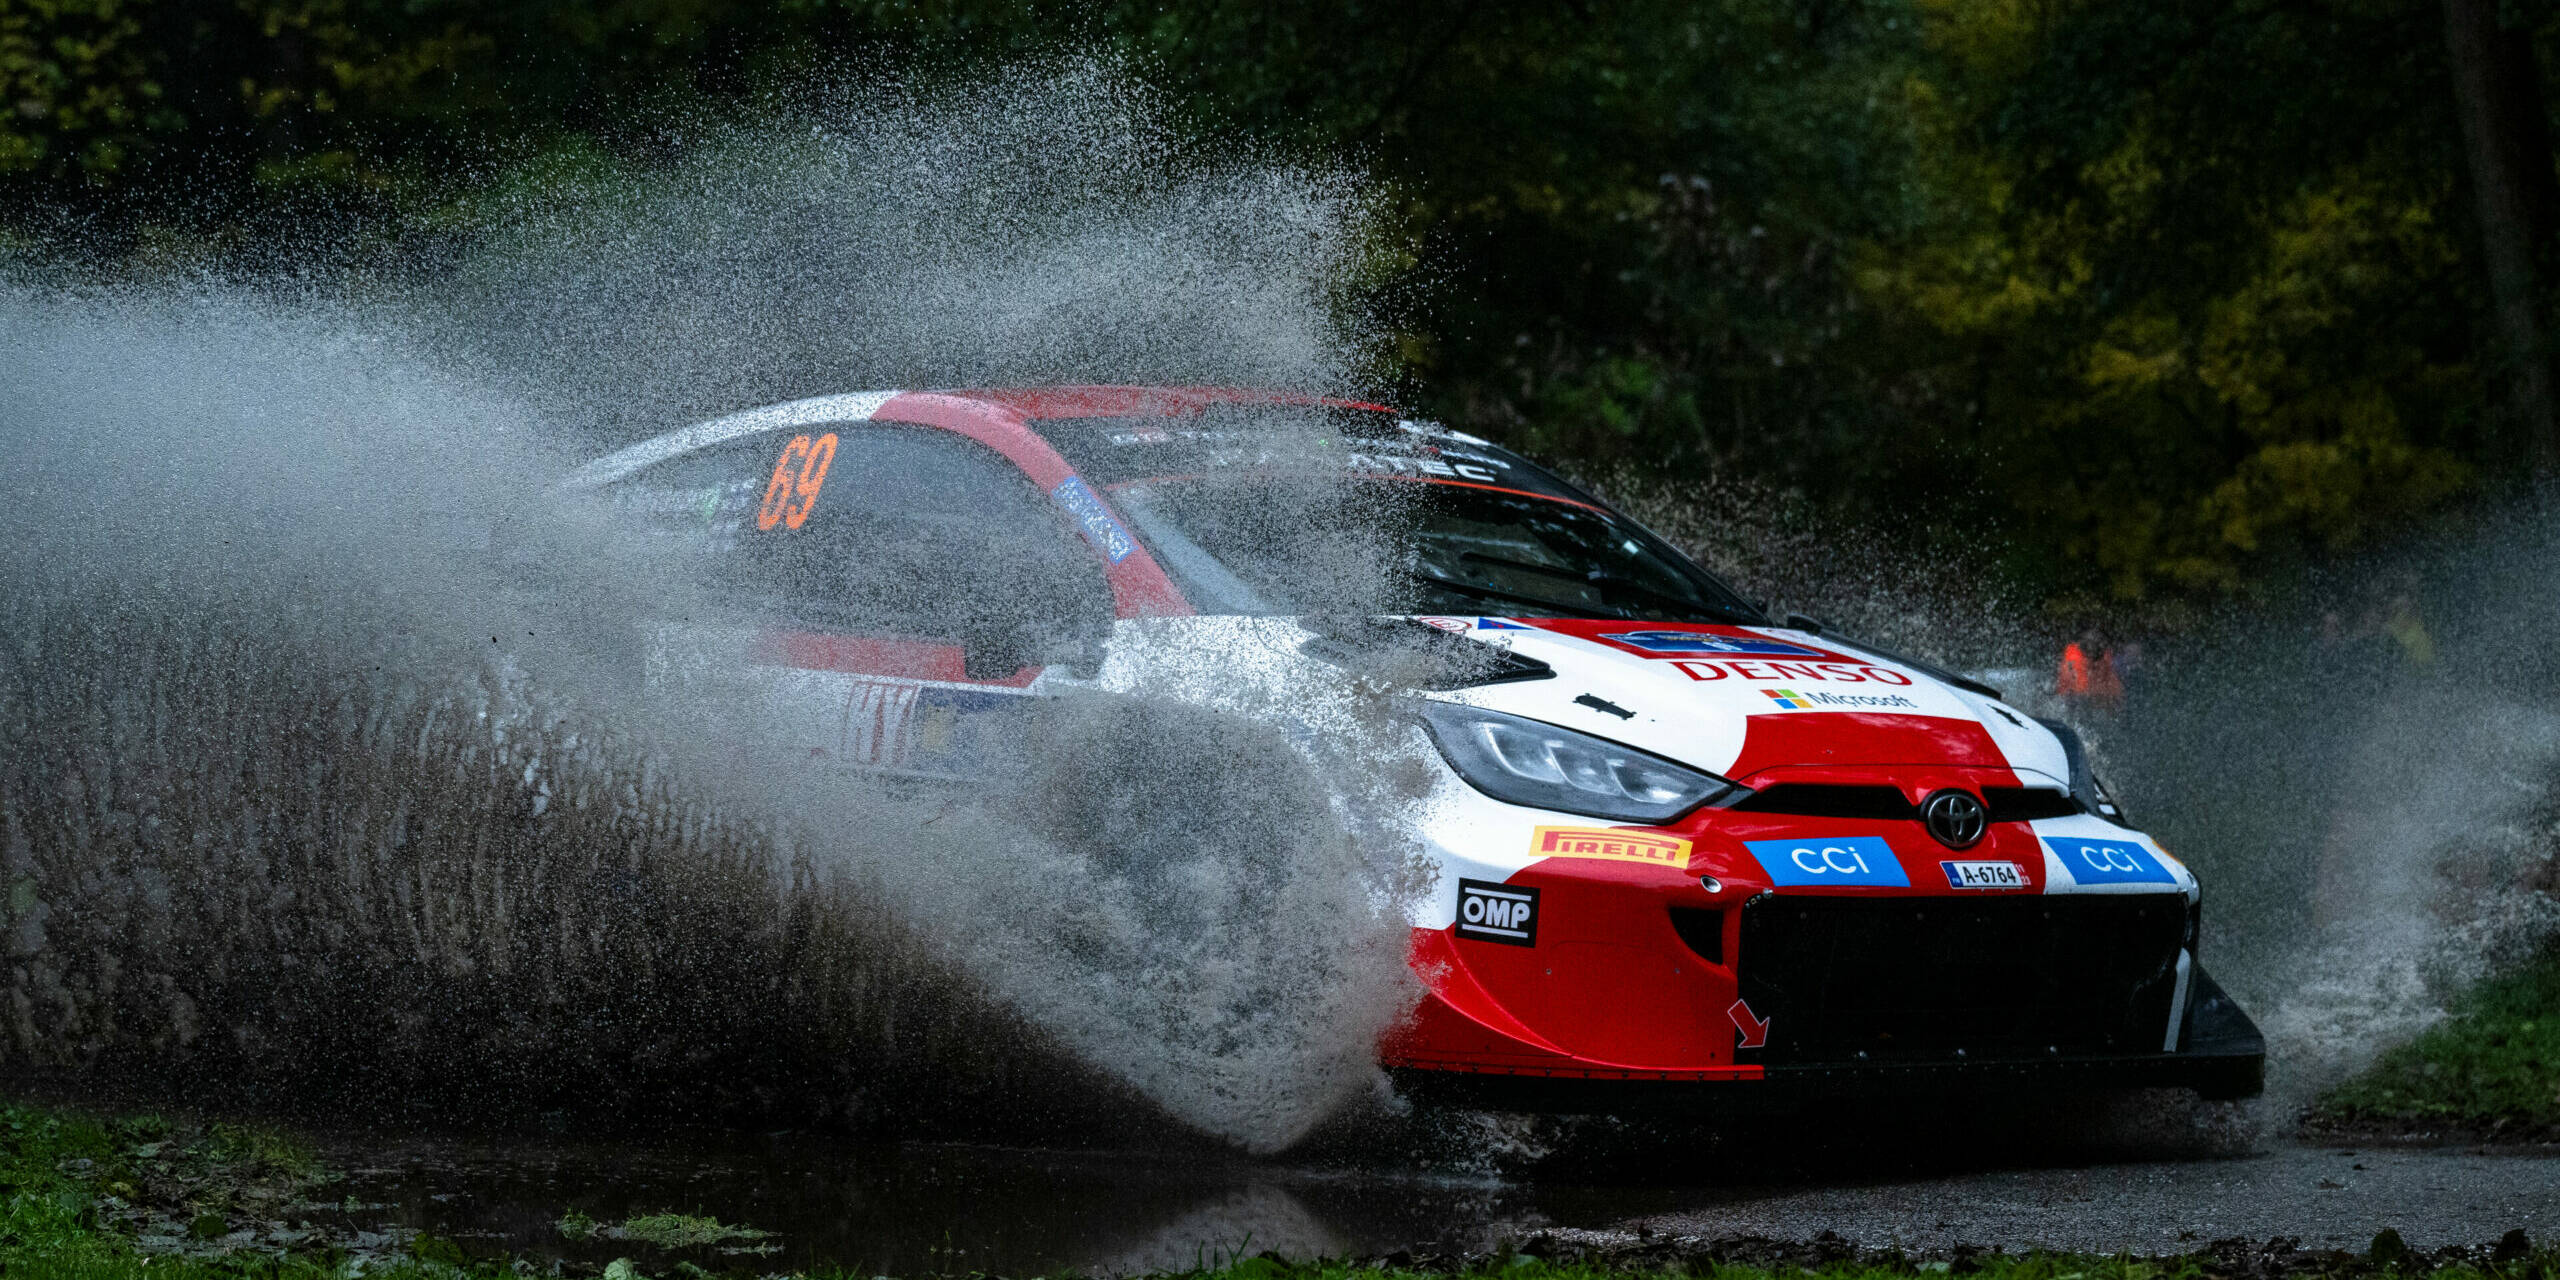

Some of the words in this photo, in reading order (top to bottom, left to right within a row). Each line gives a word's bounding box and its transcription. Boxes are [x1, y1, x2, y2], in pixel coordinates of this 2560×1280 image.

[758, 433, 838, 530] 69
[1669, 661, 1912, 686] DENSO
[1804, 692, 1918, 708] Microsoft
[1541, 831, 1680, 861] PIRELLI
[1962, 865, 2017, 883] A-6764
[1463, 896, 1531, 928] OMP
